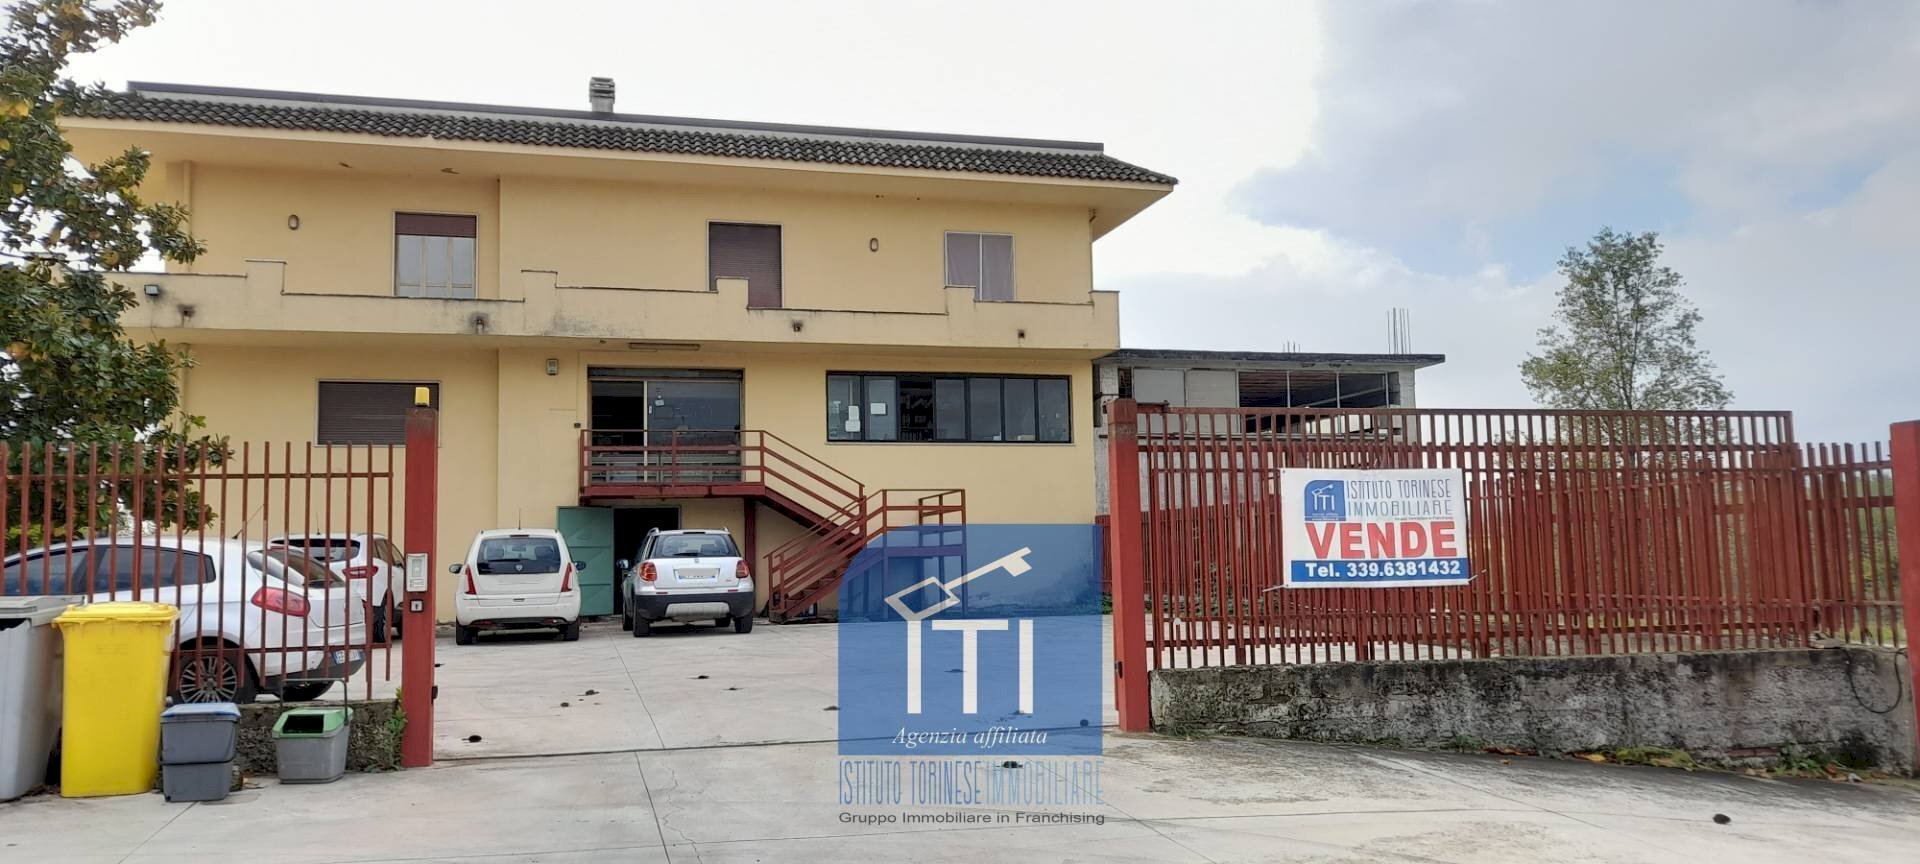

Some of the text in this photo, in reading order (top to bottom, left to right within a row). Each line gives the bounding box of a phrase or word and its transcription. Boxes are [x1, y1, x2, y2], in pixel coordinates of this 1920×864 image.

[1346, 478, 1451, 499] ISTITUTO TORINESE
[1348, 500, 1452, 516] IMMOBILIARE
[1305, 521, 1457, 559] VENDE
[1305, 560, 1461, 577] Tel. 339.6381432
